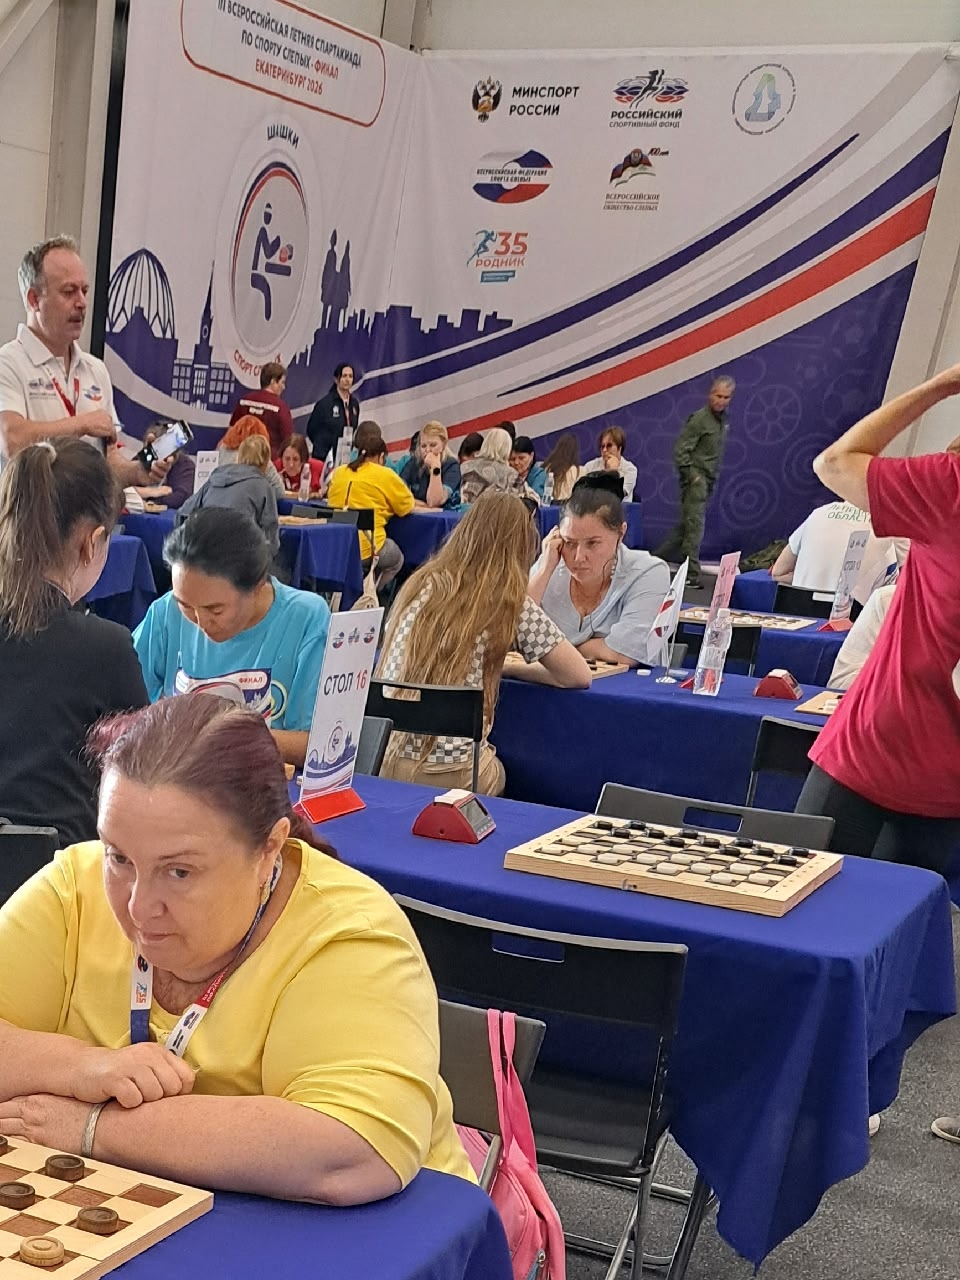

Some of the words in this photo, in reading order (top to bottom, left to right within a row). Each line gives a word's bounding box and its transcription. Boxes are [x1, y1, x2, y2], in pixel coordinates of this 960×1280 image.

[227, 0, 289, 38] ВСЕРОССИЙСКАЯ
[289, 26, 315, 49] ЛЕТНЯЯ
[315, 38, 362, 70] СПАРТАКИАДА
[241, 29, 253, 46] ПО
[254, 34, 282, 57] СПОРТУ
[282, 47, 311, 70] СЛЕПЫХ
[314, 58, 339, 80] ФИНАЛ
[255, 58, 307, 92] ЕКАТЕРИНБУРГ
[307, 78, 323, 96] 2026
[512, 86, 580, 98] МИНСПОРТ
[509, 104, 560, 116] РОССИИ
[610, 109, 683, 119] РОССИЙСКИЙ
[609, 120, 658, 128] СПОРТИВНЫЙ
[267, 123, 299, 149] ШАШКИ
[494, 232, 529, 255] 35
[476, 257, 526, 268] РОДНИК
[323, 672, 354, 696] СТОЛ
[356, 669, 367, 690] 16
